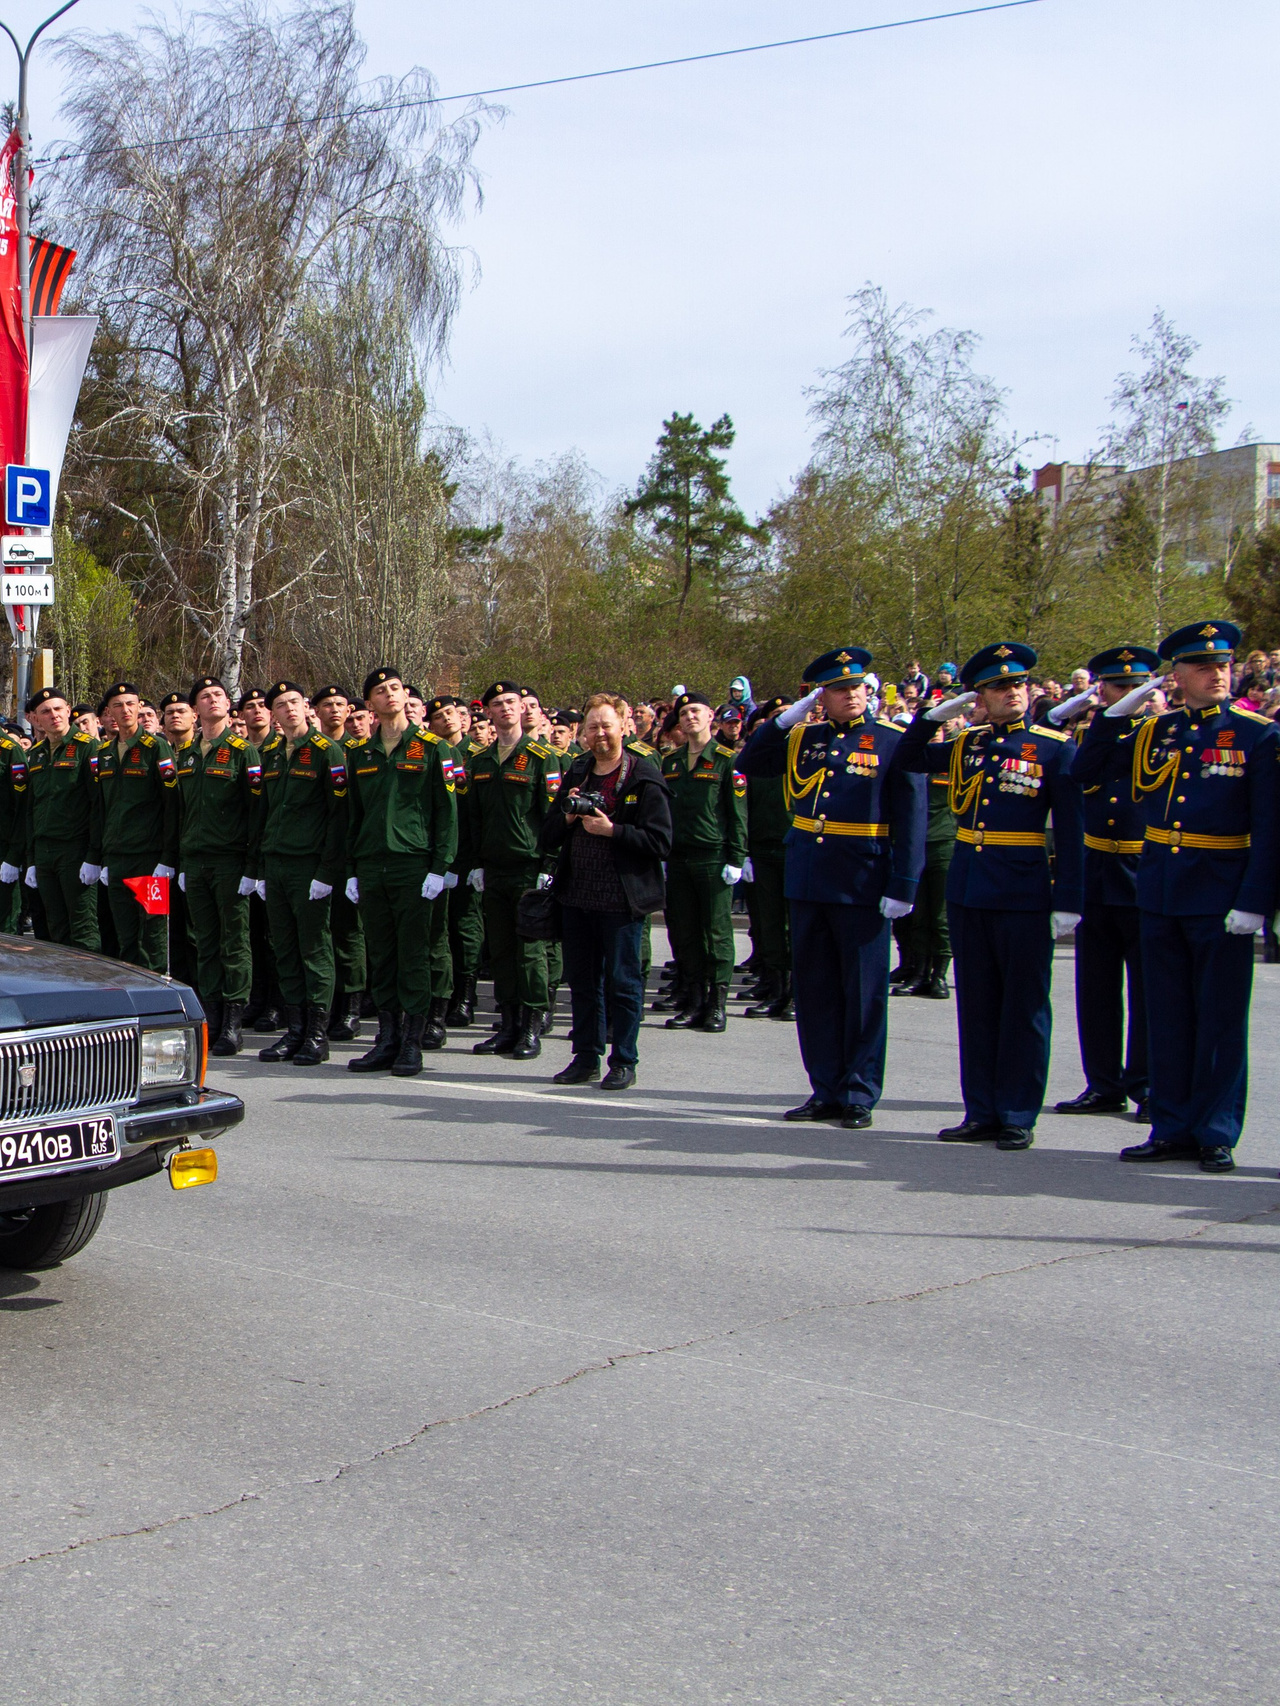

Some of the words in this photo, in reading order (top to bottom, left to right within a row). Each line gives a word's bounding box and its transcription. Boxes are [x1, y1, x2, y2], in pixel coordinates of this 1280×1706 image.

[17, 476, 42, 517] P
[88, 1121, 108, 1144] 76
[91, 1141, 108, 1155] RUS
